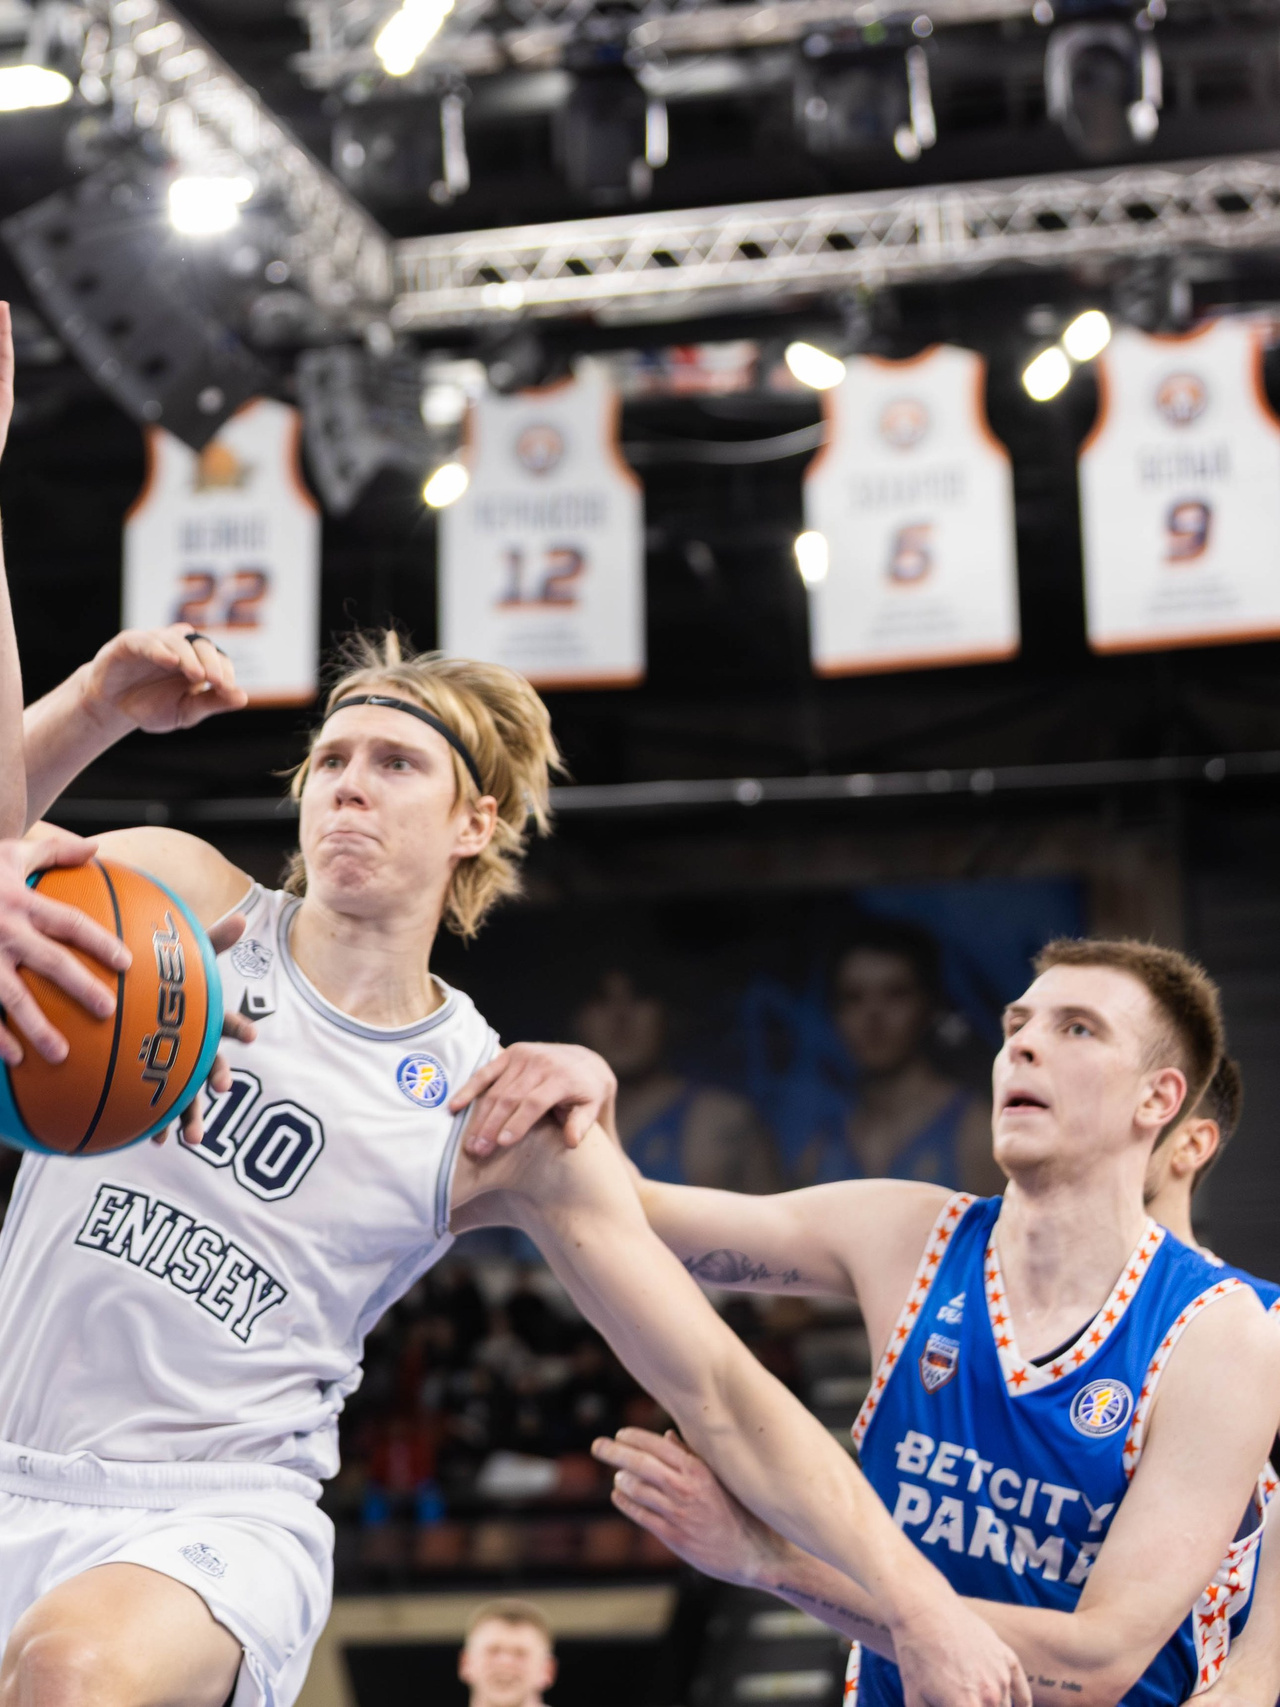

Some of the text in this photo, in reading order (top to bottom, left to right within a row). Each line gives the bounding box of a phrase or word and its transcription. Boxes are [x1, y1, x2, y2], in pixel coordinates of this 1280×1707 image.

[1163, 496, 1212, 565] 9
[173, 567, 269, 629] 22
[492, 545, 586, 612] 12
[177, 1067, 325, 1202] 10
[74, 1183, 288, 1343] ENISEY
[895, 1429, 1115, 1532] BETCITY
